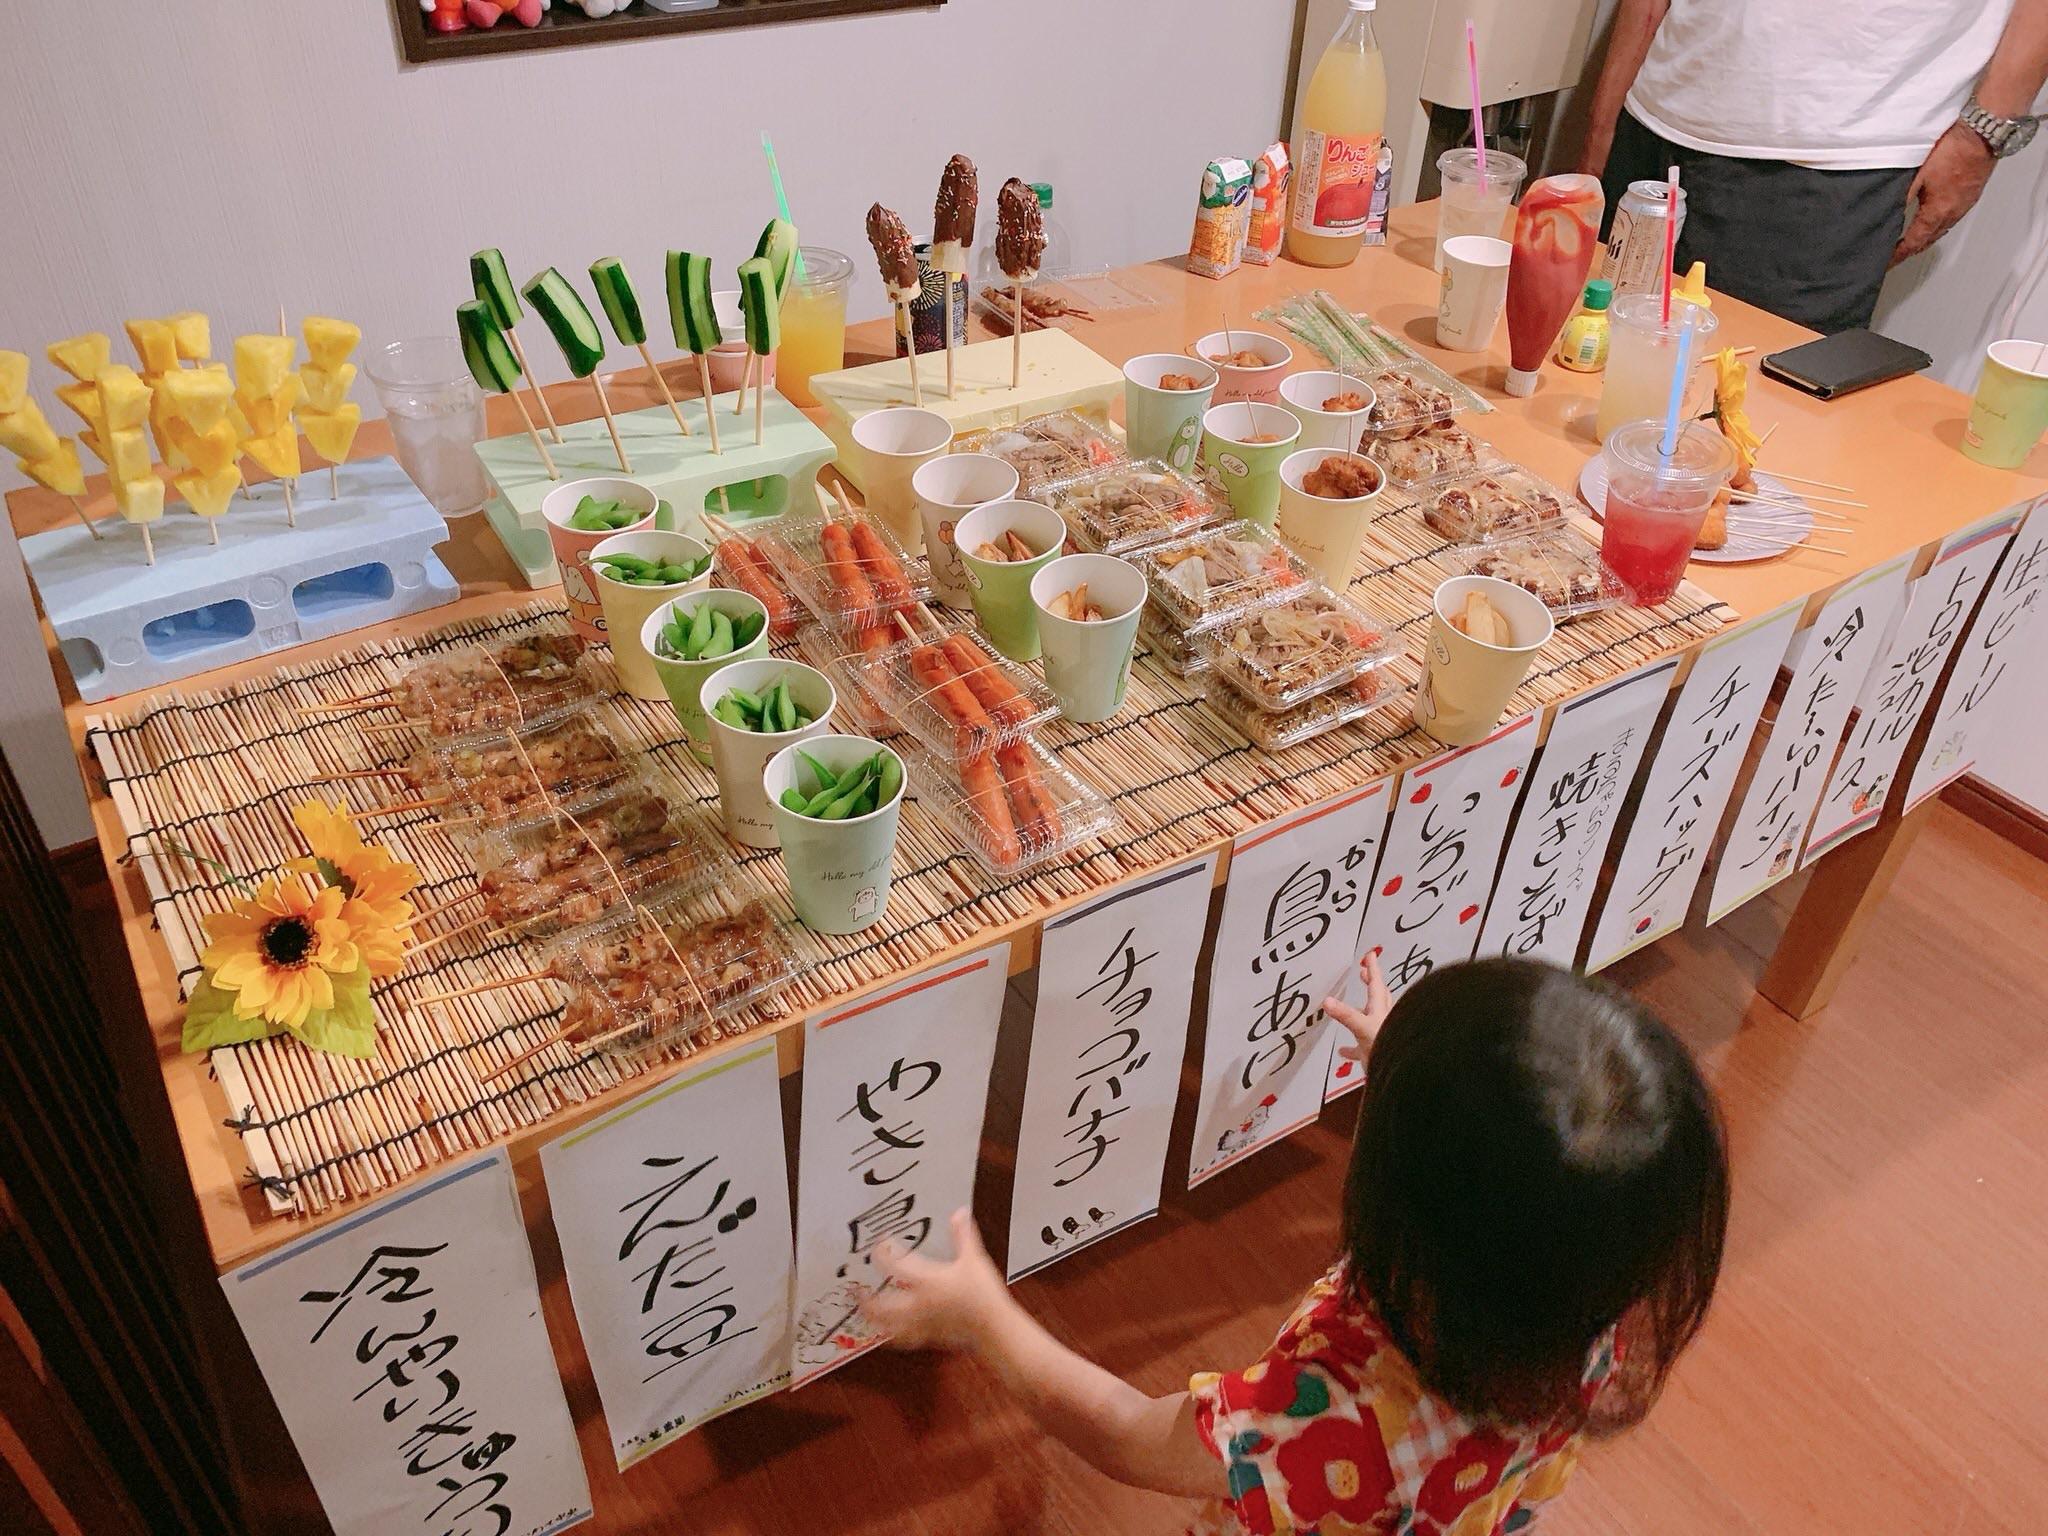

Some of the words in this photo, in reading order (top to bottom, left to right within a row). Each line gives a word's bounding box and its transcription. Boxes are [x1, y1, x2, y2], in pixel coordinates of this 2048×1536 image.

[1326, 138, 1370, 163] りんご
[1877, 566, 1976, 745] トロピカル
[737, 815, 758, 827] Hello
[1629, 665, 1751, 913] チーズハットグ
[822, 871, 846, 881] Hello
[1333, 838, 1376, 914] から
[1052, 927, 1160, 1188] チョコバナナ
